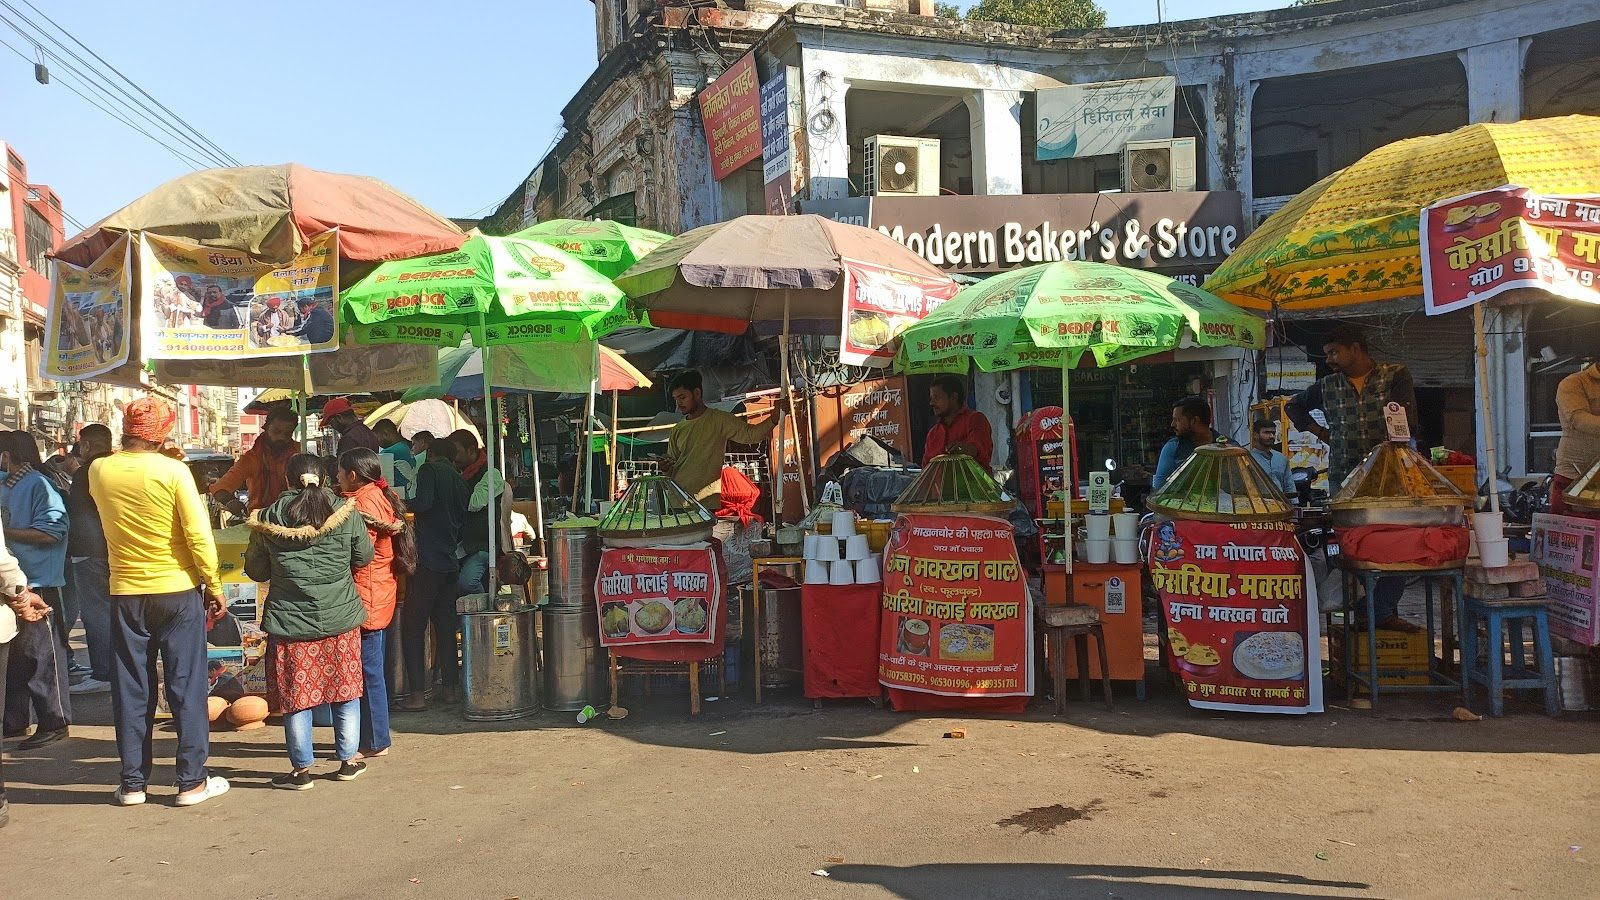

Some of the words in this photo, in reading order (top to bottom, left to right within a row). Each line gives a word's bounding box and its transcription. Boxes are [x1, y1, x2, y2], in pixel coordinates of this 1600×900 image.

[1140, 103, 1168, 120] सेवा
[878, 225, 996, 264] Modern
[1004, 220, 1115, 262] Baker's
[1124, 219, 1149, 259] &
[1157, 218, 1237, 259] Store
[399, 268, 477, 282] BEDROCK
[387, 293, 447, 310] BEDROCK
[528, 291, 581, 303] BEDROCK
[1057, 320, 1120, 336] BEDROCK
[166, 344, 245, 352] 9140860428
[931, 334, 975, 351] BEDROCK
[843, 392, 865, 409] वाहन
[1040, 417, 1063, 430] BING
[956, 526, 969, 538] की
[934, 545, 948, 553] जय
[1222, 541, 1267, 561] गोपाल
[914, 556, 981, 582] मक्खन
[984, 552, 1020, 582] वाले
[635, 571, 669, 594] मलाई
[672, 572, 708, 592] मक्खन
[1151, 561, 1231, 599] केसरिया
[1238, 574, 1303, 600] मक्खन
[925, 595, 967, 622] मलाई
[969, 601, 1019, 621] मक्खन
[1169, 602, 1203, 623] मुन्ना
[1208, 605, 1257, 624] मक्खन
[1261, 604, 1290, 624] वाले
[907, 658, 916, 667] के
[934, 664, 961, 673] अवसर
[963, 666, 974, 674] पर
[1187, 681, 1197, 693] के
[1200, 683, 1217, 697] शुभ
[1219, 685, 1247, 698] अवसर
[1250, 687, 1262, 698] पर
